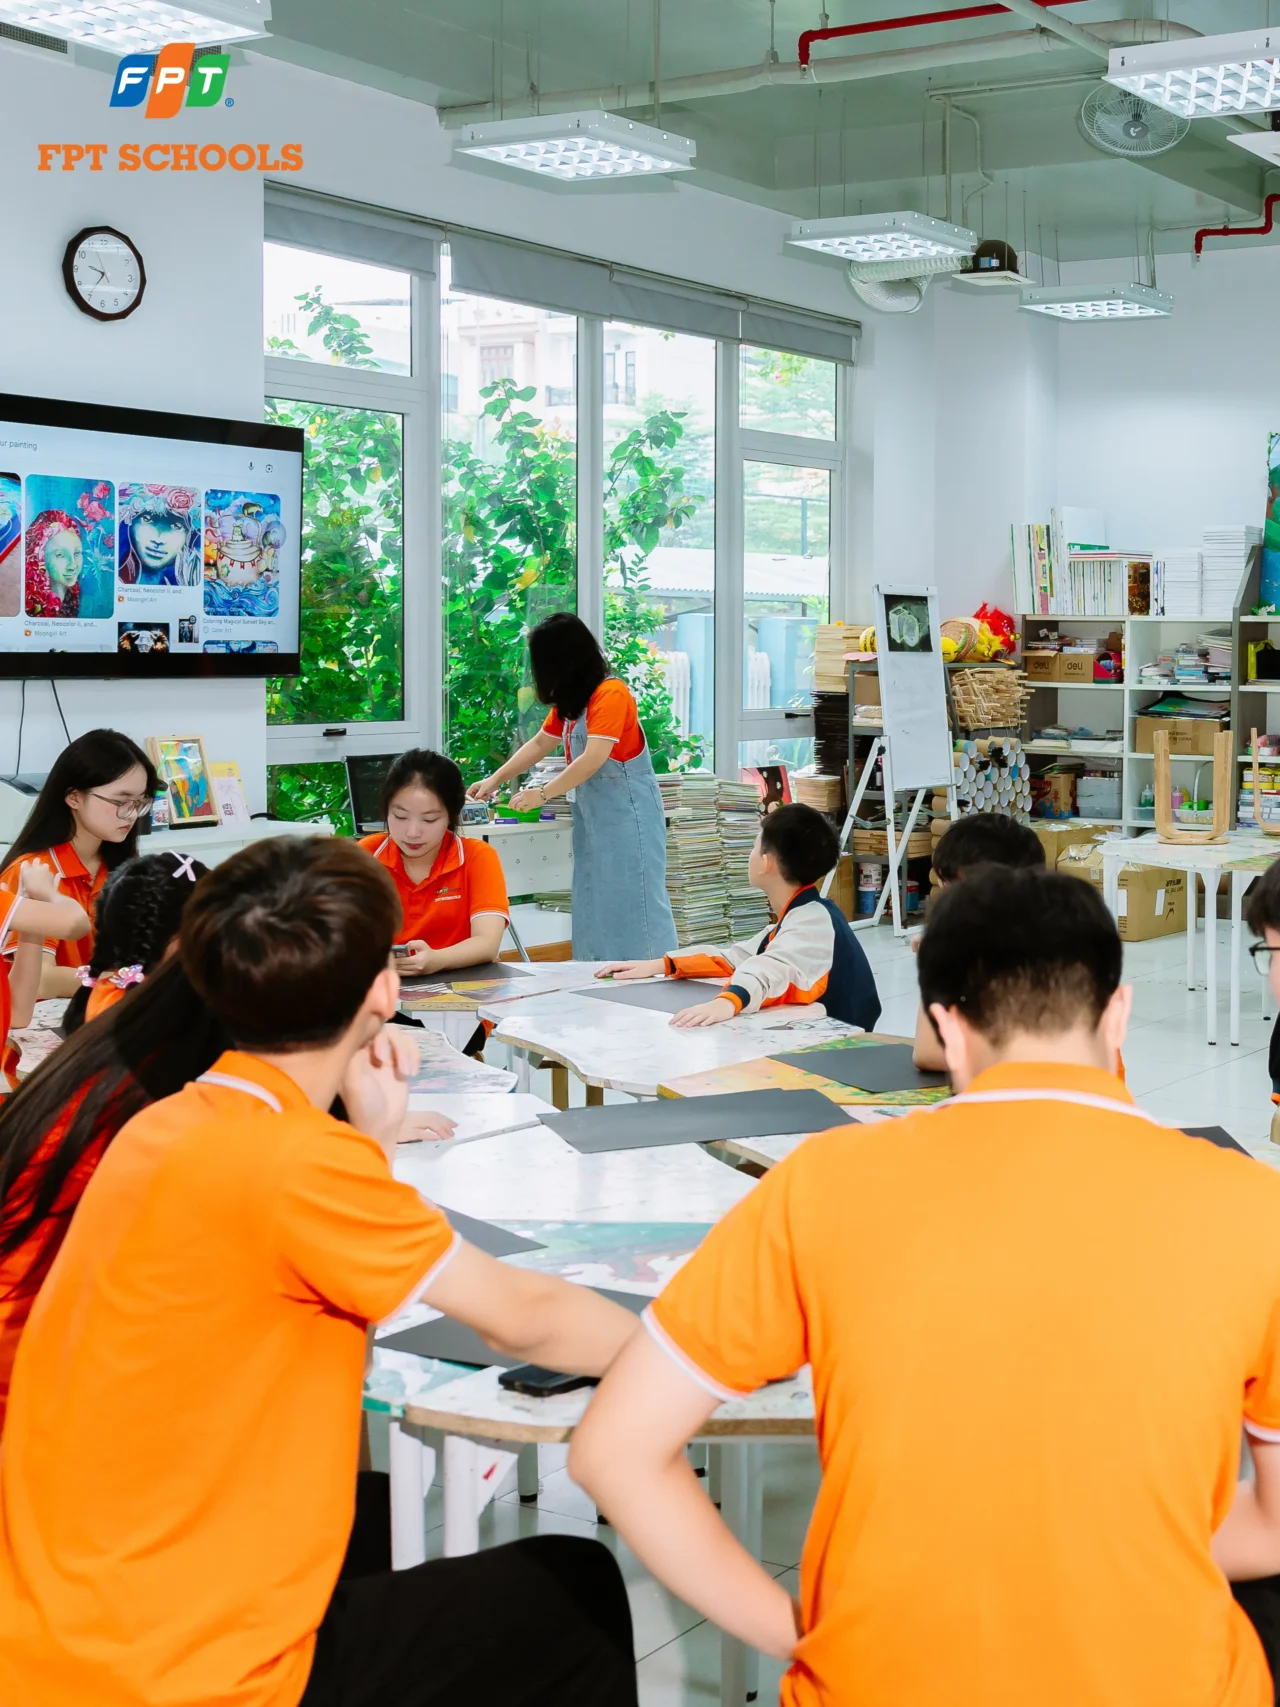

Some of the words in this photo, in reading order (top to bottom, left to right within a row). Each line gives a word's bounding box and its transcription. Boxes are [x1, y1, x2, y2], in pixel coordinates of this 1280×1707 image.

[77, 250, 86, 259] 10
[73, 264, 79, 273] 9
[127, 274, 133, 283] 3
[100, 299, 106, 308] 6
[113, 298, 119, 307] 5
[9, 440, 38, 451] painting
[1066, 661, 1083, 671] deli
